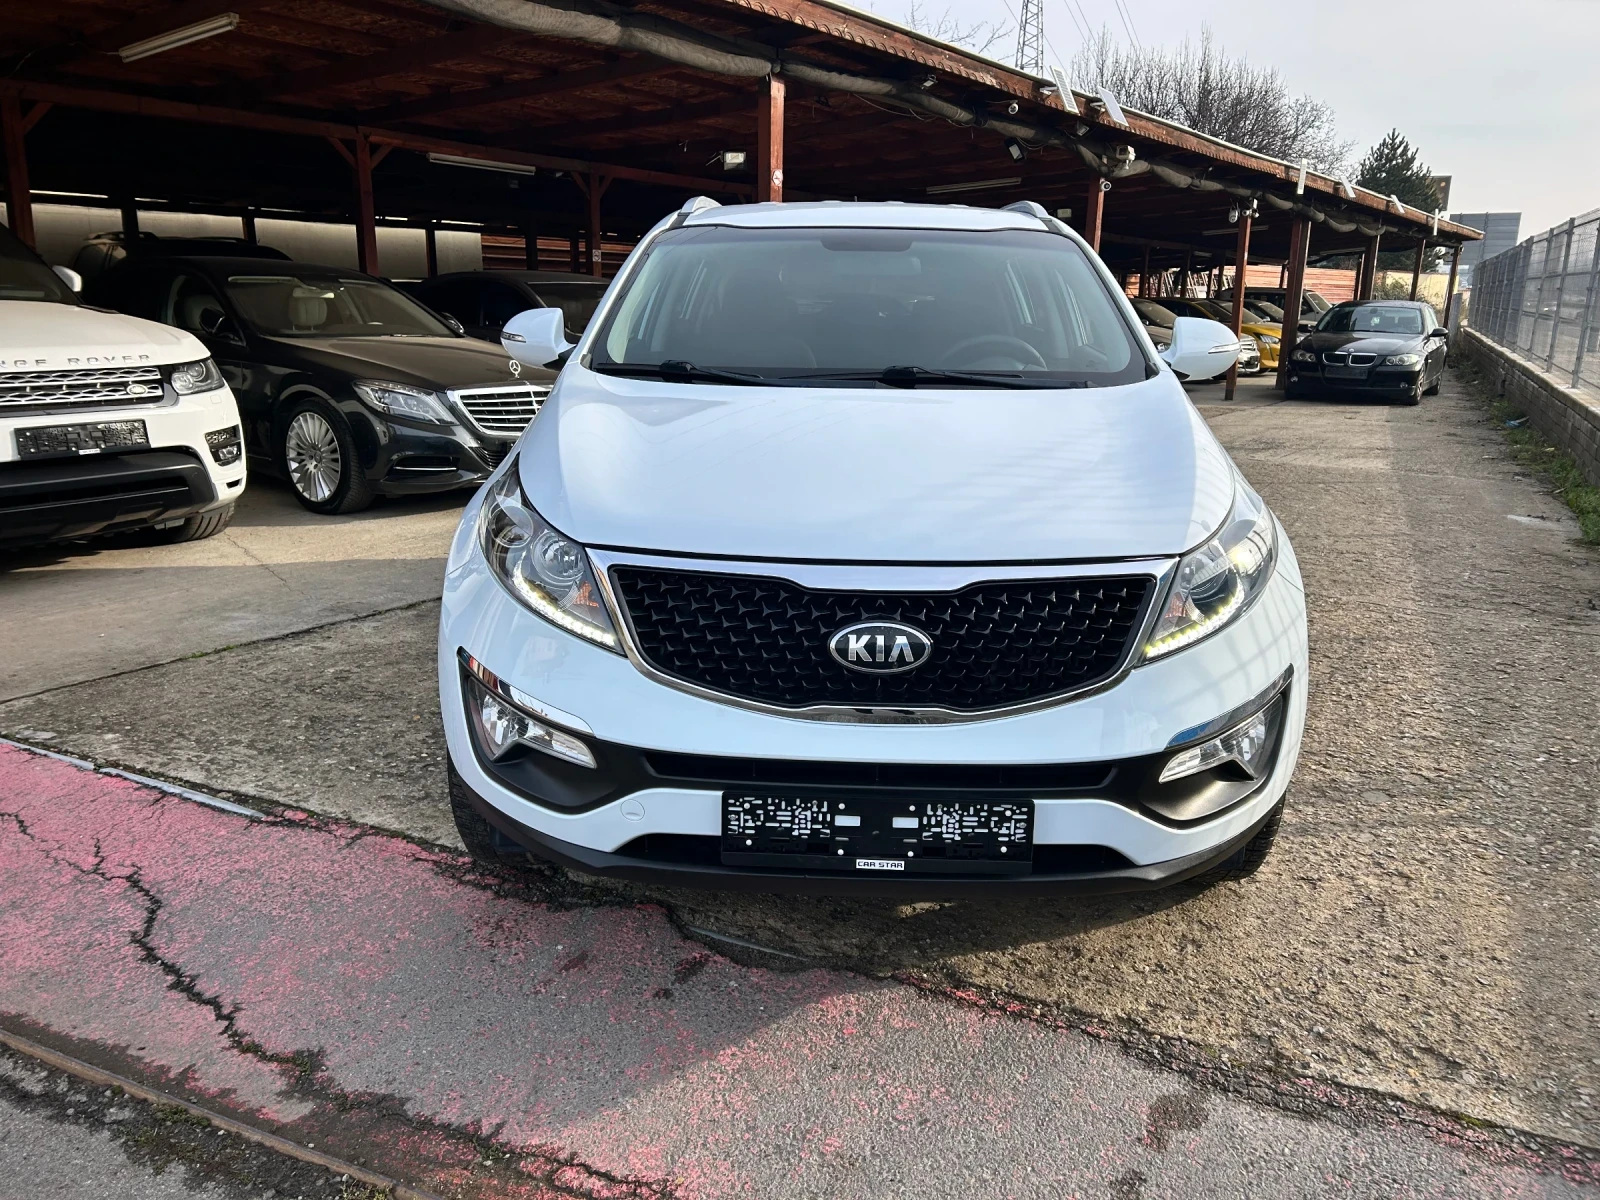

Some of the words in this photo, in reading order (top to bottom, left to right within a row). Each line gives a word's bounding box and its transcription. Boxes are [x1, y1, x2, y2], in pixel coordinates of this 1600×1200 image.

[67, 354, 151, 366] ROVER
[847, 634, 915, 662] KIA
[878, 861, 903, 869] STAR
